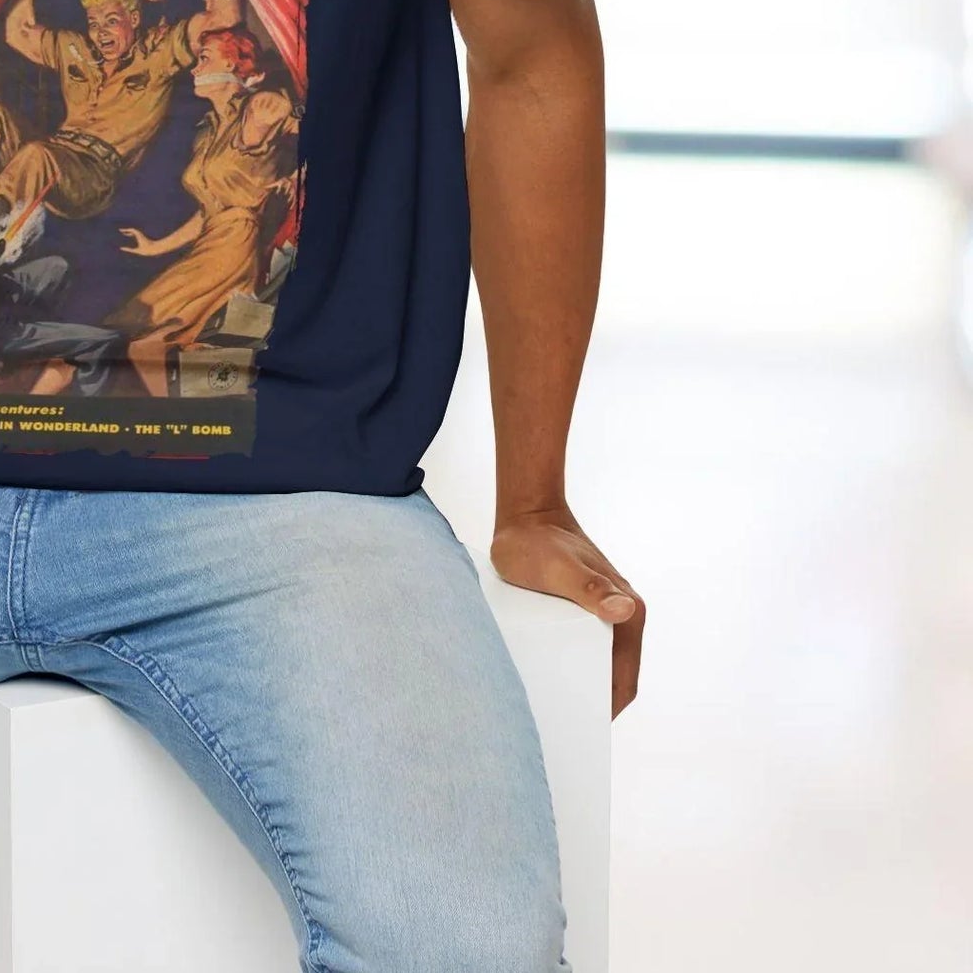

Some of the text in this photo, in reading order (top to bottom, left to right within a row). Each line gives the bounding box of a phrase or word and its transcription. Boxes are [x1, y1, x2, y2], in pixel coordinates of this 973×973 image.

[0, 421, 13, 430] IN
[19, 421, 120, 433] WONDERLAND
[135, 424, 161, 434] THE
[192, 425, 232, 435] BOMB
